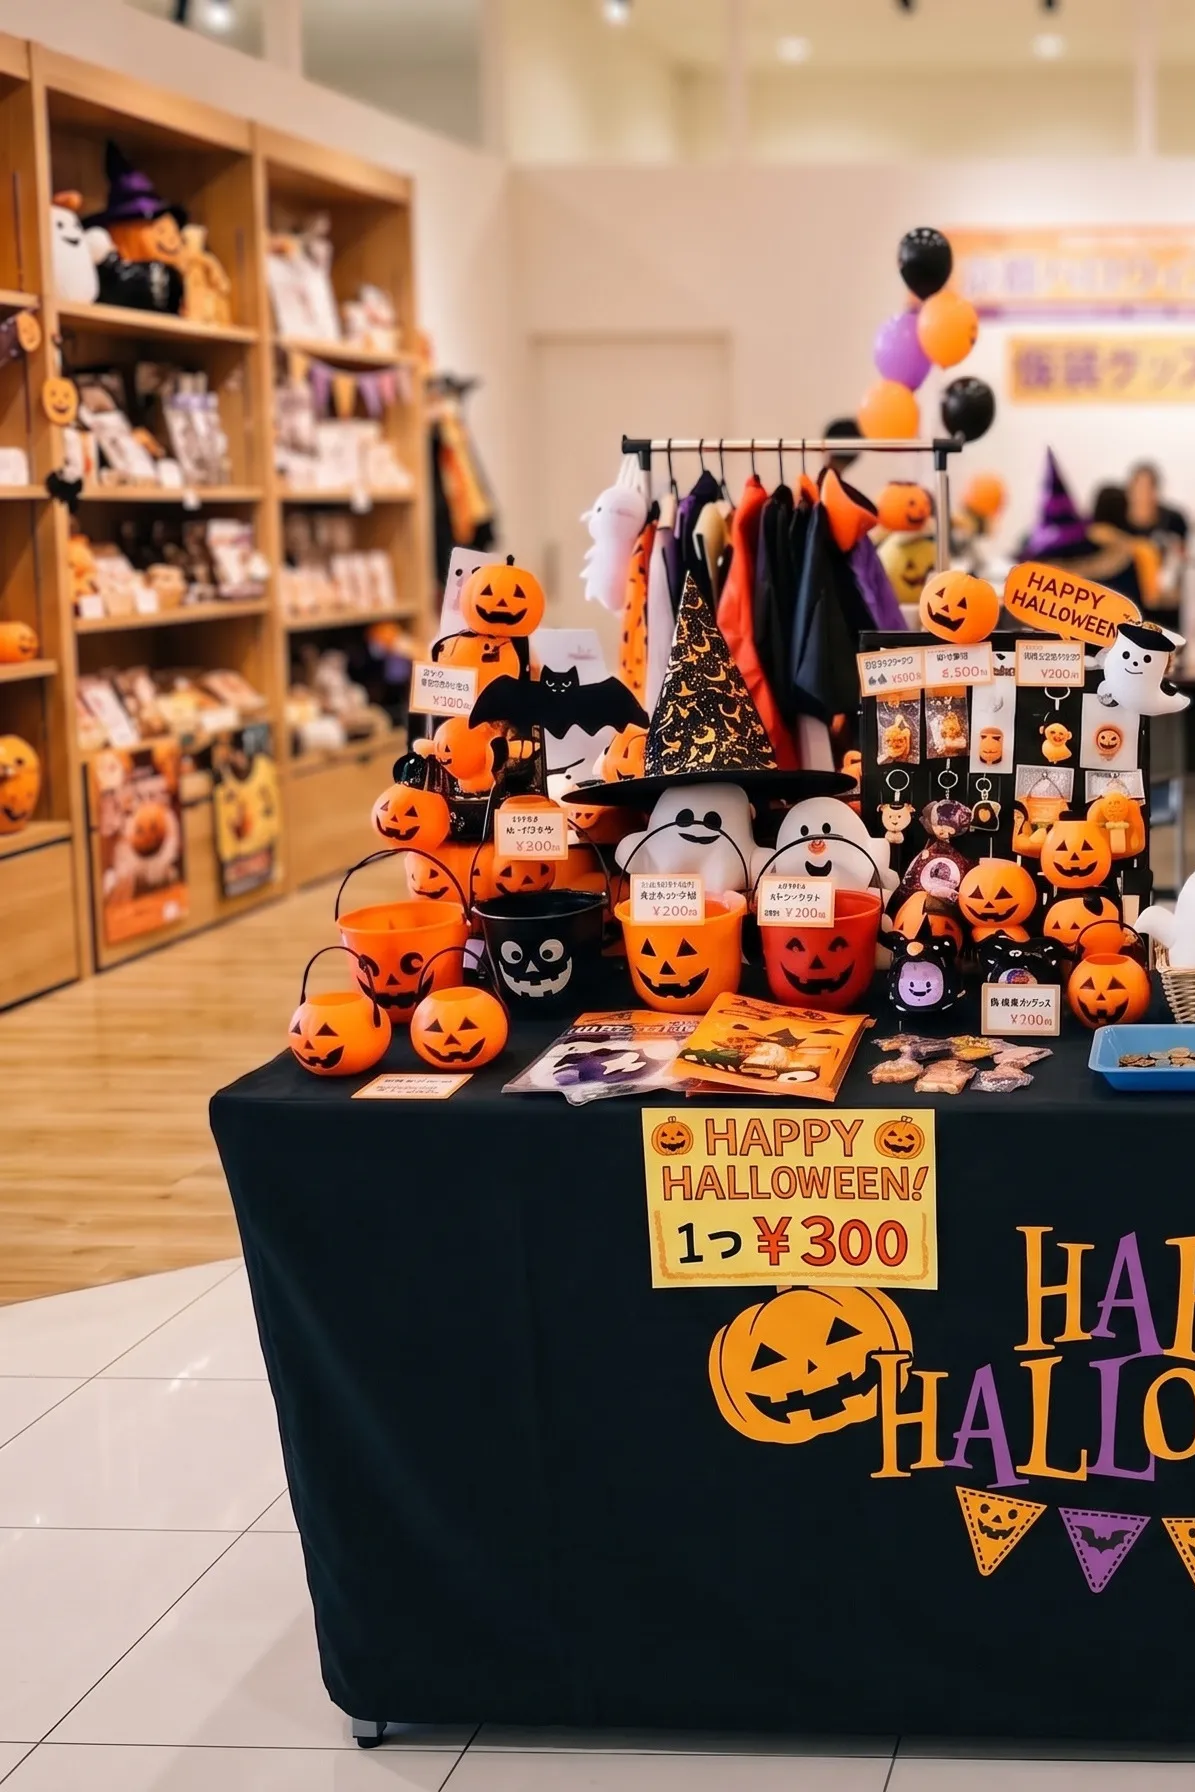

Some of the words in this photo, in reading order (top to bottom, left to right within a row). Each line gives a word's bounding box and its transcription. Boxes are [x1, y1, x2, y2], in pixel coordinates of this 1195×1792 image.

[1027, 571, 1106, 610] HAPPY
[1011, 588, 1118, 639] HALLOWEEN
[705, 1118, 864, 1157] HAPPY
[662, 1165, 929, 1201] HALLOWEEN!
[677, 1222, 742, 1264] 1つ
[752, 1215, 909, 1267] ¥300
